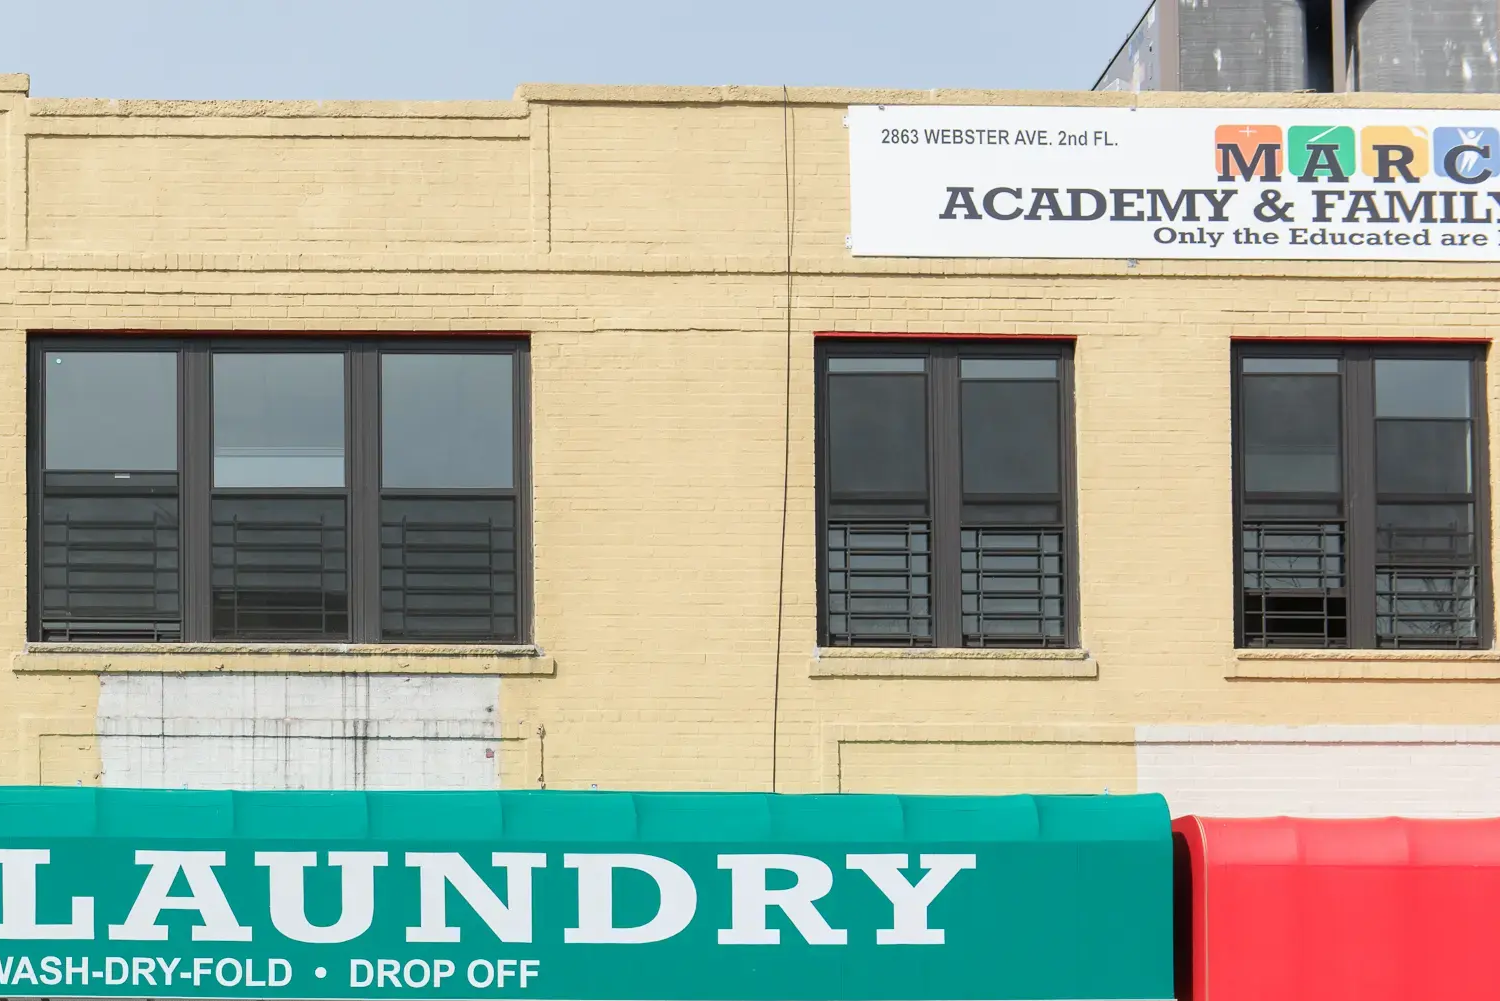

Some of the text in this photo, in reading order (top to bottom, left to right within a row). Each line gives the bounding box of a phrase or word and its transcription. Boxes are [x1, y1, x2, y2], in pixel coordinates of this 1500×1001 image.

[881, 128, 1118, 146] 2863 WEBSTER AVE. 2nd FL.
[1217, 143, 1493, 184] MARC
[938, 186, 1238, 222] ACADEMY
[1253, 189, 1295, 223] &
[1153, 227, 1488, 248] Only the Educated are
[349, 958, 455, 988] DROP
[467, 959, 540, 988] OFF
